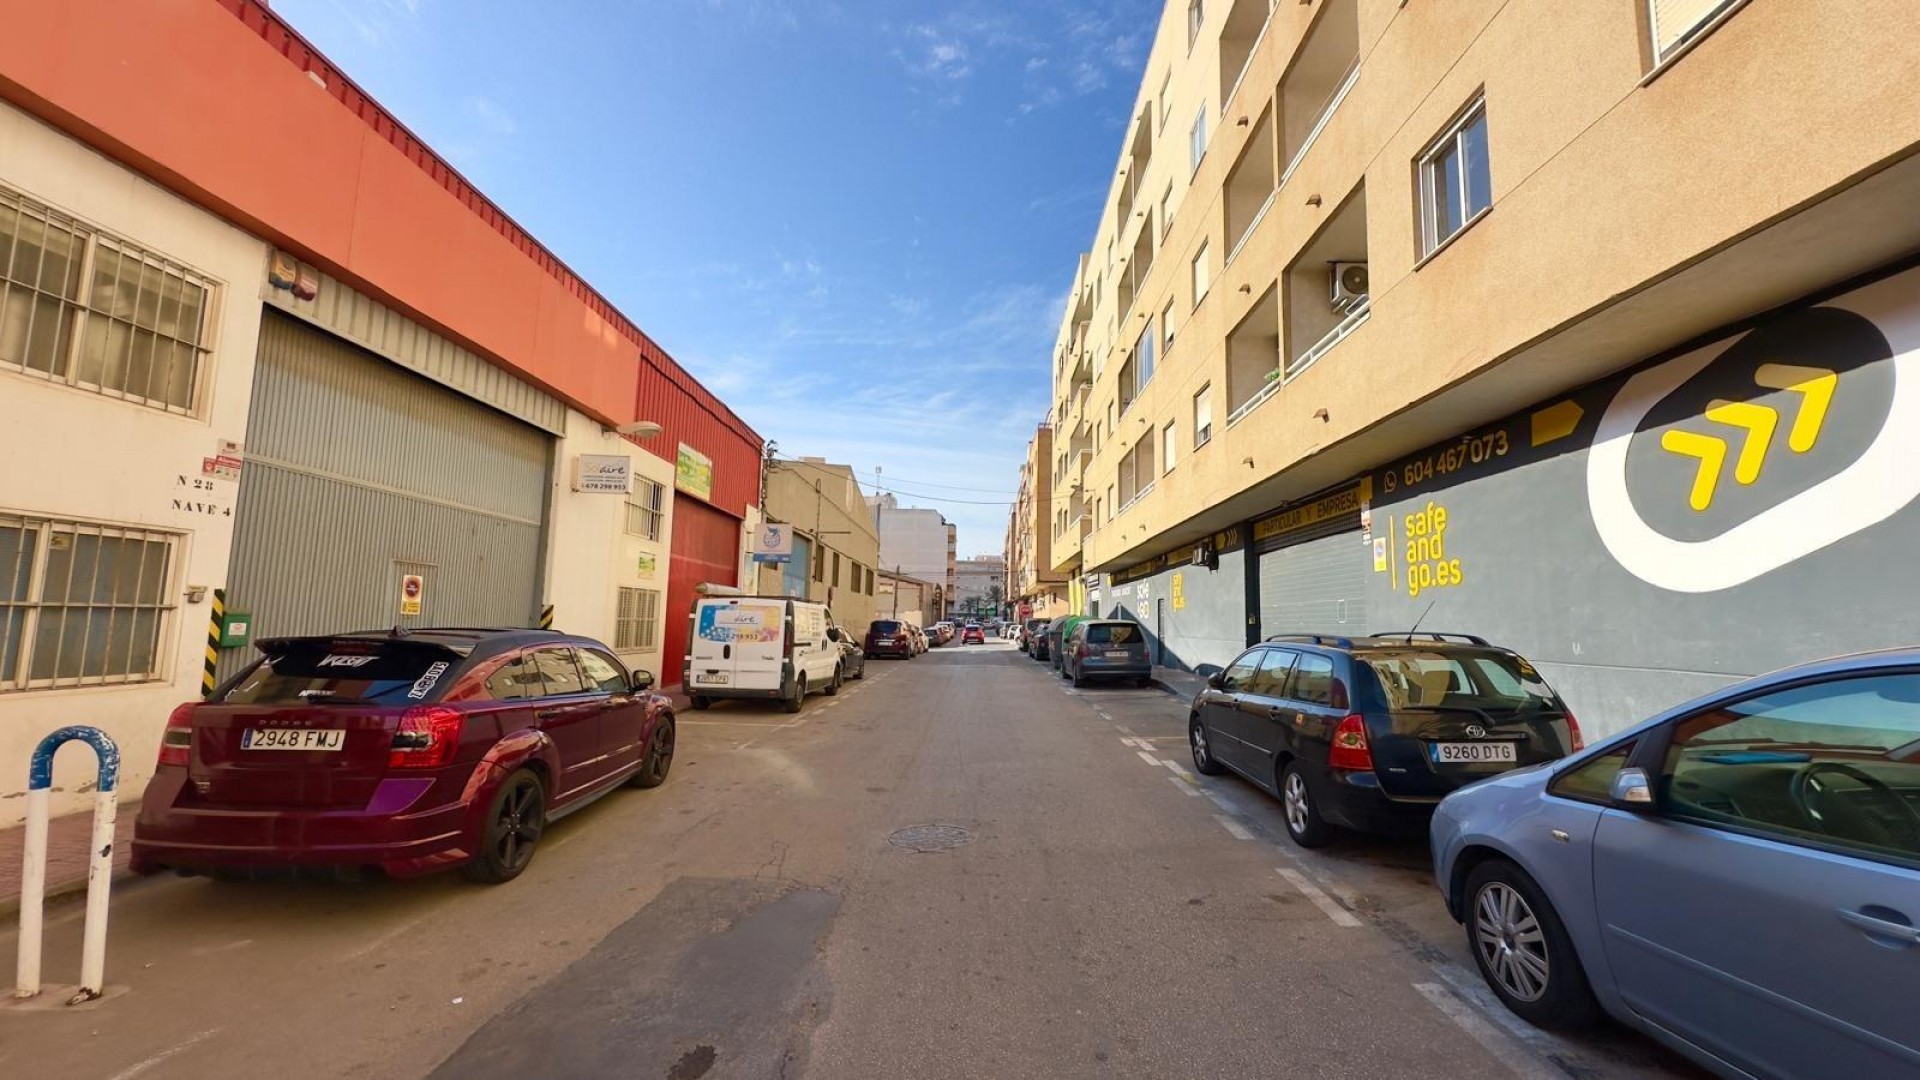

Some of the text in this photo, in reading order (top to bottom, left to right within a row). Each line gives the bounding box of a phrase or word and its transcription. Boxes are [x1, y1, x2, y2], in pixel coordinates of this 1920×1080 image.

[1404, 430, 1509, 486] 604 467 073
[193, 479, 213, 491] 28
[172, 499, 231, 517] NAVE 4
[1317, 490, 1359, 519] EMPRESA
[1405, 502, 1447, 538] safe
[1406, 529, 1442, 564] and
[1408, 558, 1463, 597] go.es
[254, 731, 340, 748] 2948 FMJ
[1443, 745, 1511, 759] 9260 DTG
